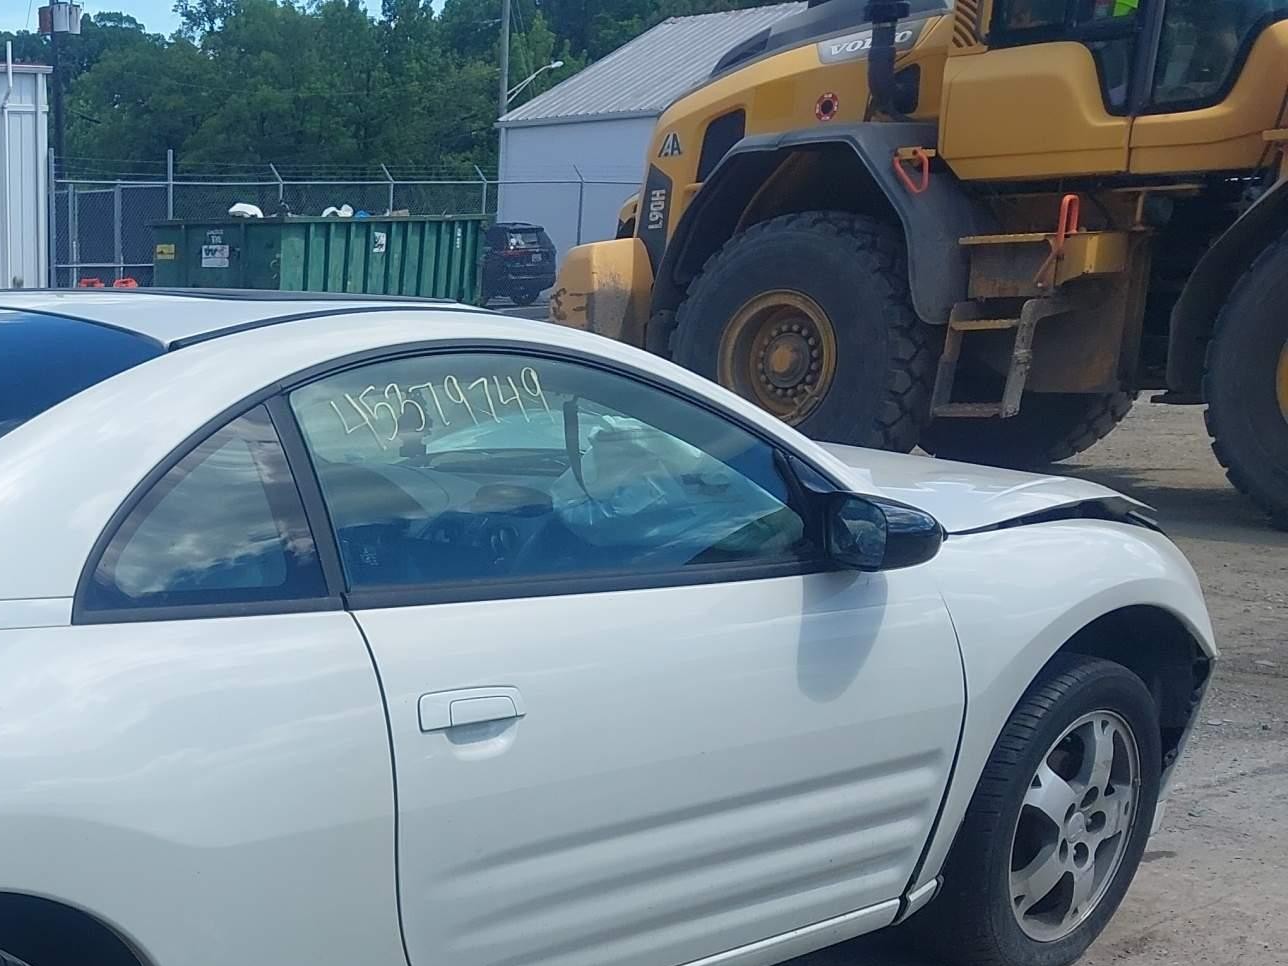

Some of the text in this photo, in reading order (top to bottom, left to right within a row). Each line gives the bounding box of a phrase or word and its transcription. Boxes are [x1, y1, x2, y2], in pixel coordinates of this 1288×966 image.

[830, 30, 913, 55] VOLO
[648, 189, 666, 230] L90H
[330, 366, 556, 451] 45379749
